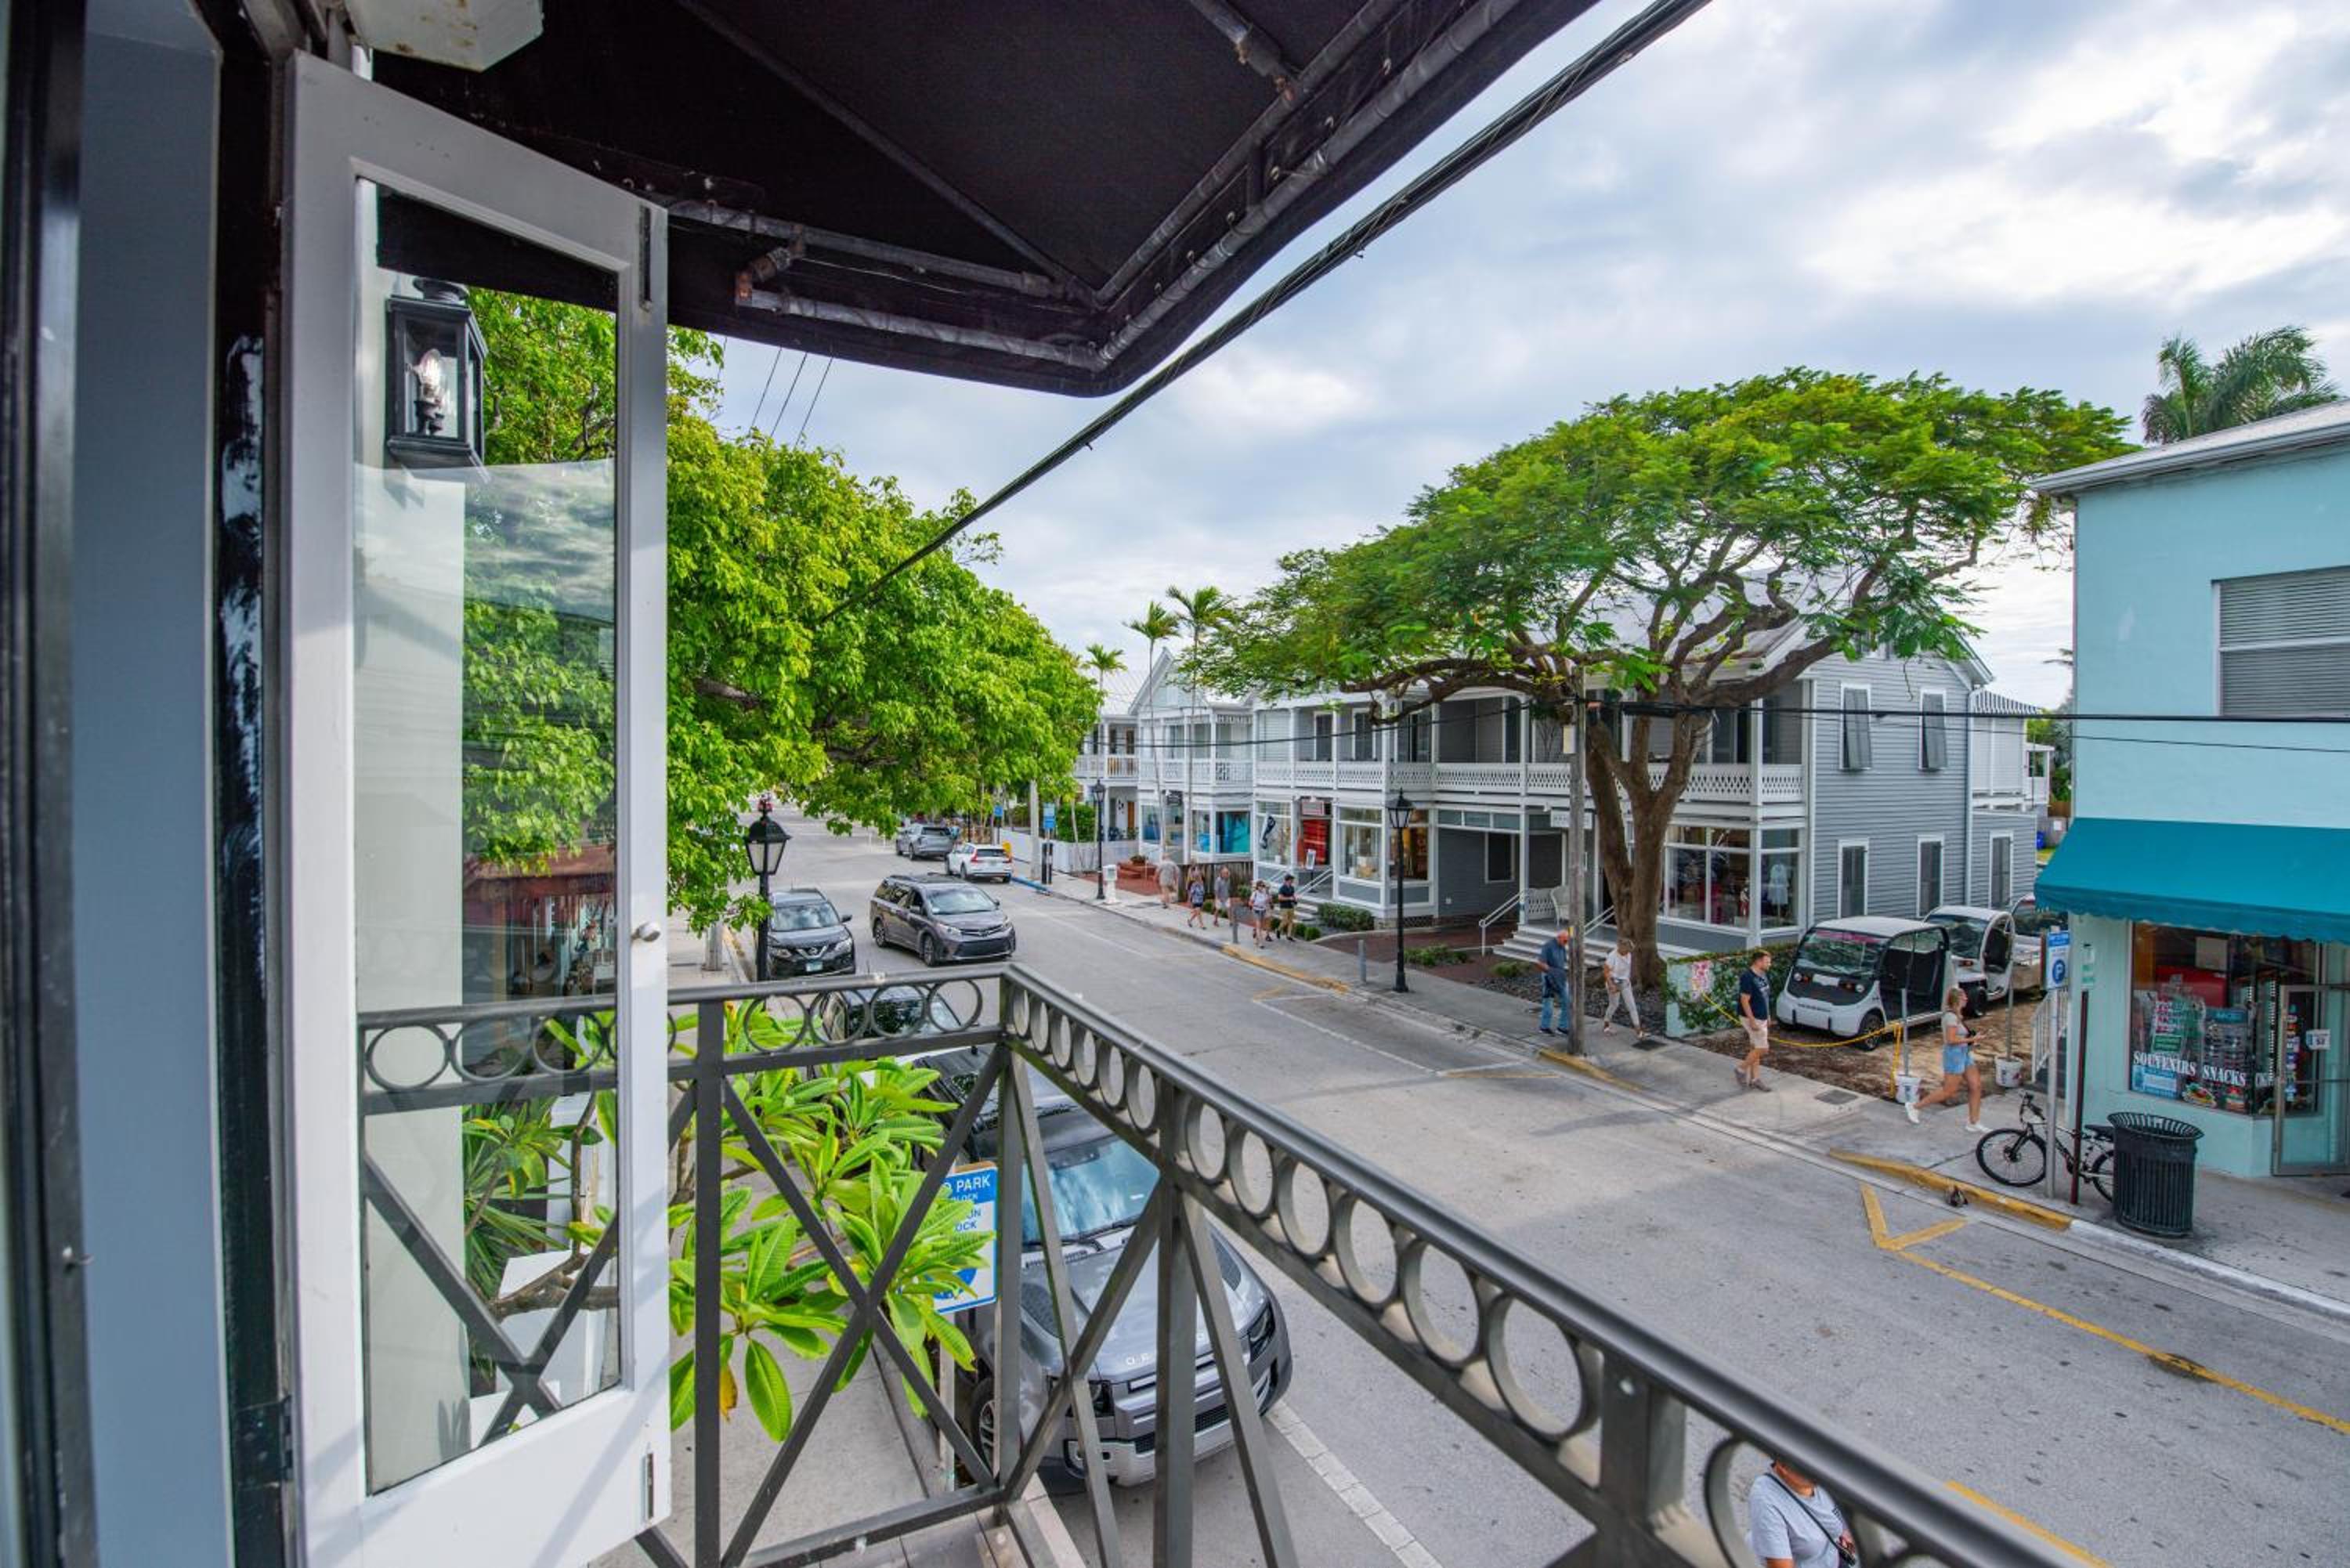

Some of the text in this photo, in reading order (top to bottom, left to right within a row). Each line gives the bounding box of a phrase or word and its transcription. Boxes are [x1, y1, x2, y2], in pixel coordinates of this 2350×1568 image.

[2134, 1051, 2196, 1076] SOUVENIRS
[2203, 1065, 2246, 1086] SNACKS
[956, 1175, 990, 1192] PARK
